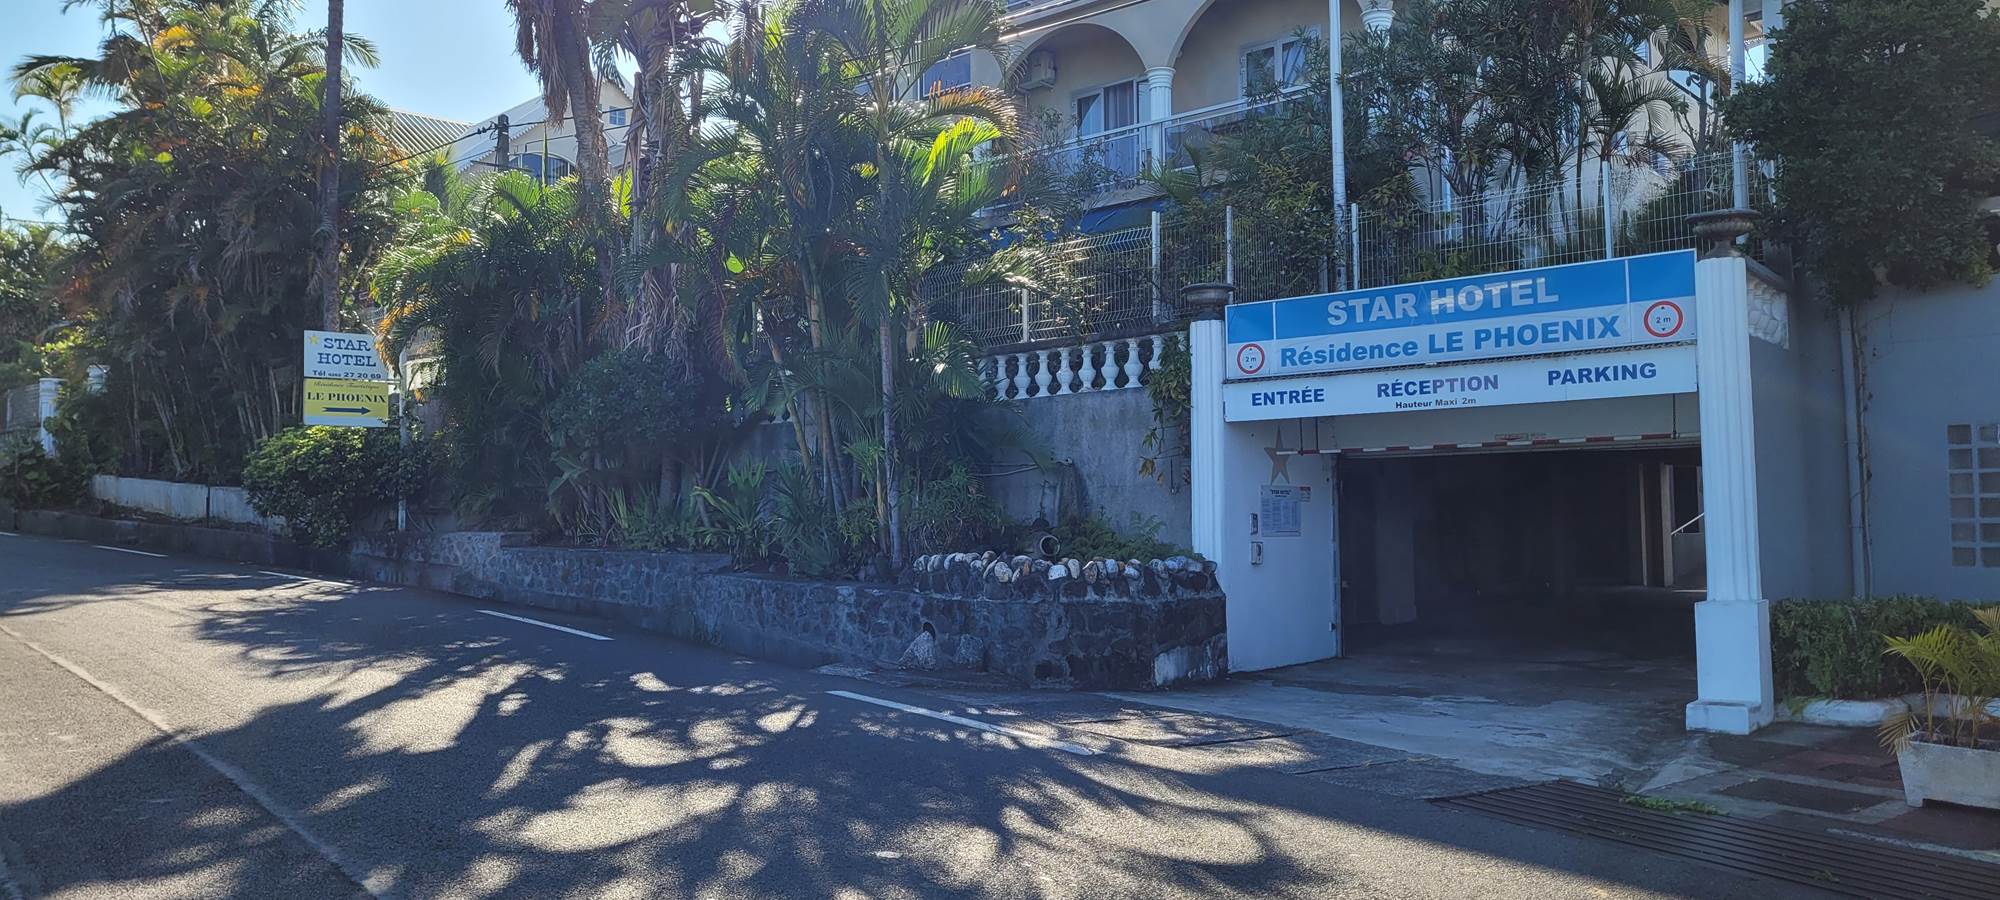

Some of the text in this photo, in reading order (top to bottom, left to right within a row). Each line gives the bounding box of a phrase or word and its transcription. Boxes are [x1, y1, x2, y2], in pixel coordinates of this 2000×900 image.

[1327, 277, 1559, 326] STAR HOTEL
[323, 337, 371, 352] STAR
[1280, 315, 1621, 367] Résidence LE PHOENIX
[316, 352, 377, 367] HOTEL
[1251, 362, 1657, 407] ENTRÉE RÉCEPTION PARKING
[307, 391, 386, 403] LE PHOENIX
[1395, 397, 1477, 409] Hauteur Maxi 2m
